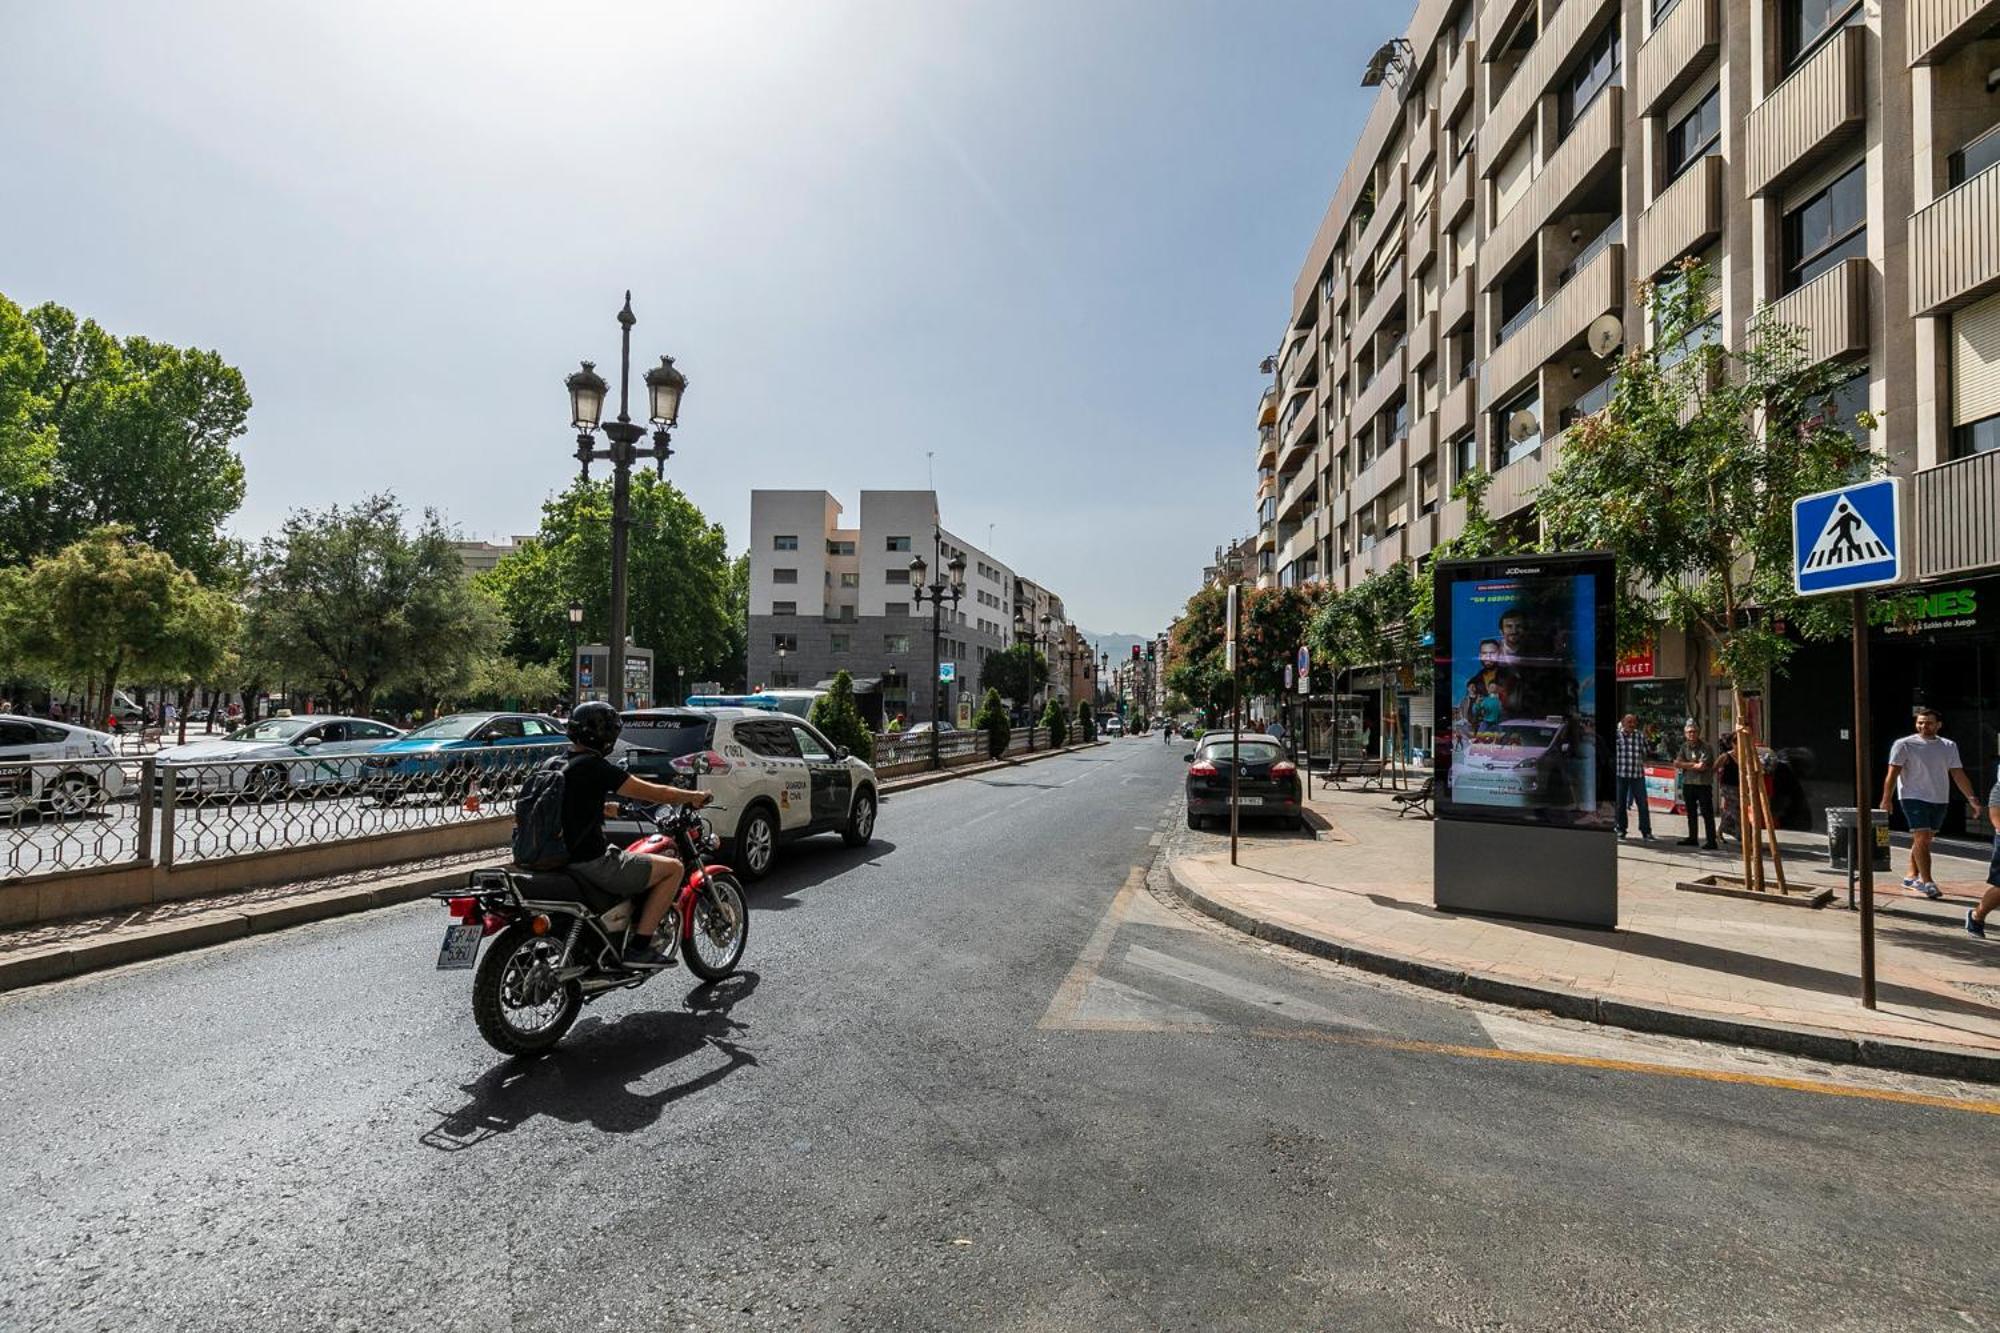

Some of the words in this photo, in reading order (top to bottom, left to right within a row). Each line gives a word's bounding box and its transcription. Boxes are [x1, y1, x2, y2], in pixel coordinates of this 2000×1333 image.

[1943, 620, 1953, 628] de
[1954, 619, 1977, 627] Juego
[1617, 663, 1650, 675] ARKET
